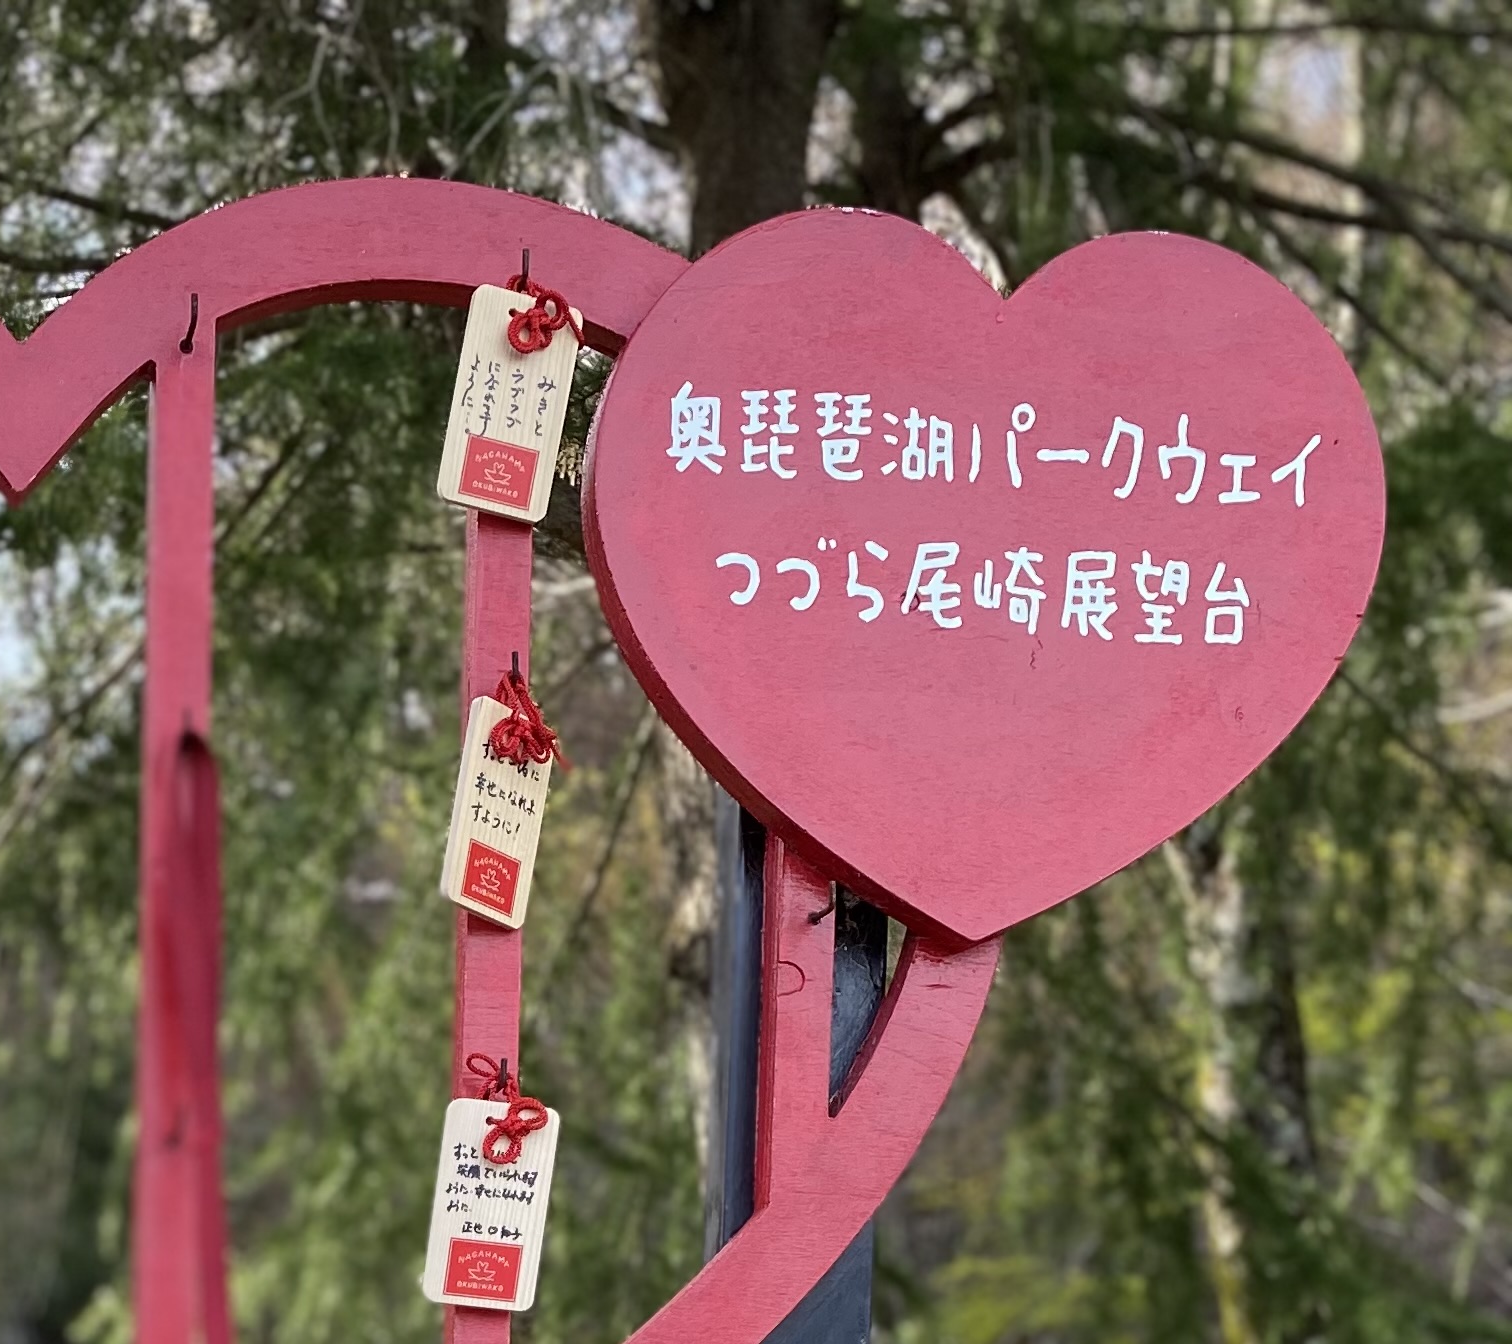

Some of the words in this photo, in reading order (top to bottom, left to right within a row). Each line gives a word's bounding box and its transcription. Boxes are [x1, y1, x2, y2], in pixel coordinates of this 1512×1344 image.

[666, 380, 1324, 508] 奥琵琶湖パークウェイ
[474, 450, 526, 473] NAGAHAMA
[472, 480, 519, 499] OKUBIWAKO
[714, 536, 1253, 647] つづら尾崎展望台
[457, 1249, 510, 1268] NAGAHAMA
[456, 1280, 504, 1293] OKUBIWAKO
